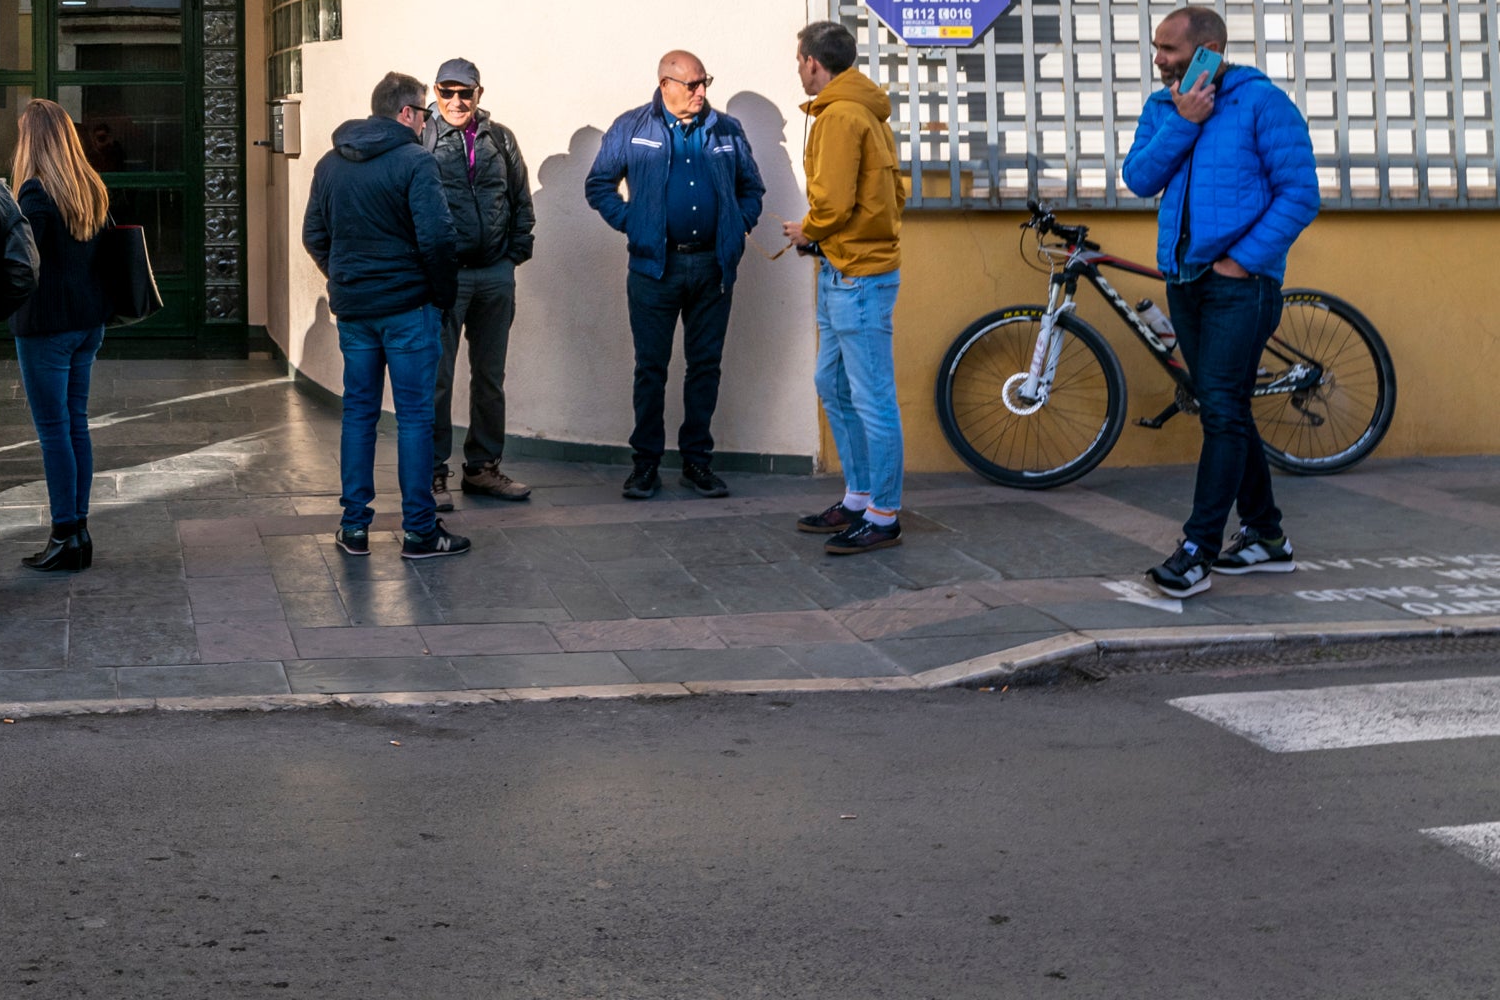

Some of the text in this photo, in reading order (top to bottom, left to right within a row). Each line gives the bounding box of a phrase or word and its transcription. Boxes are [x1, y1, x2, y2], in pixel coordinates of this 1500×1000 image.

[913, 7, 972, 20] 112 016
[1003, 310, 1043, 319] MAXXI
